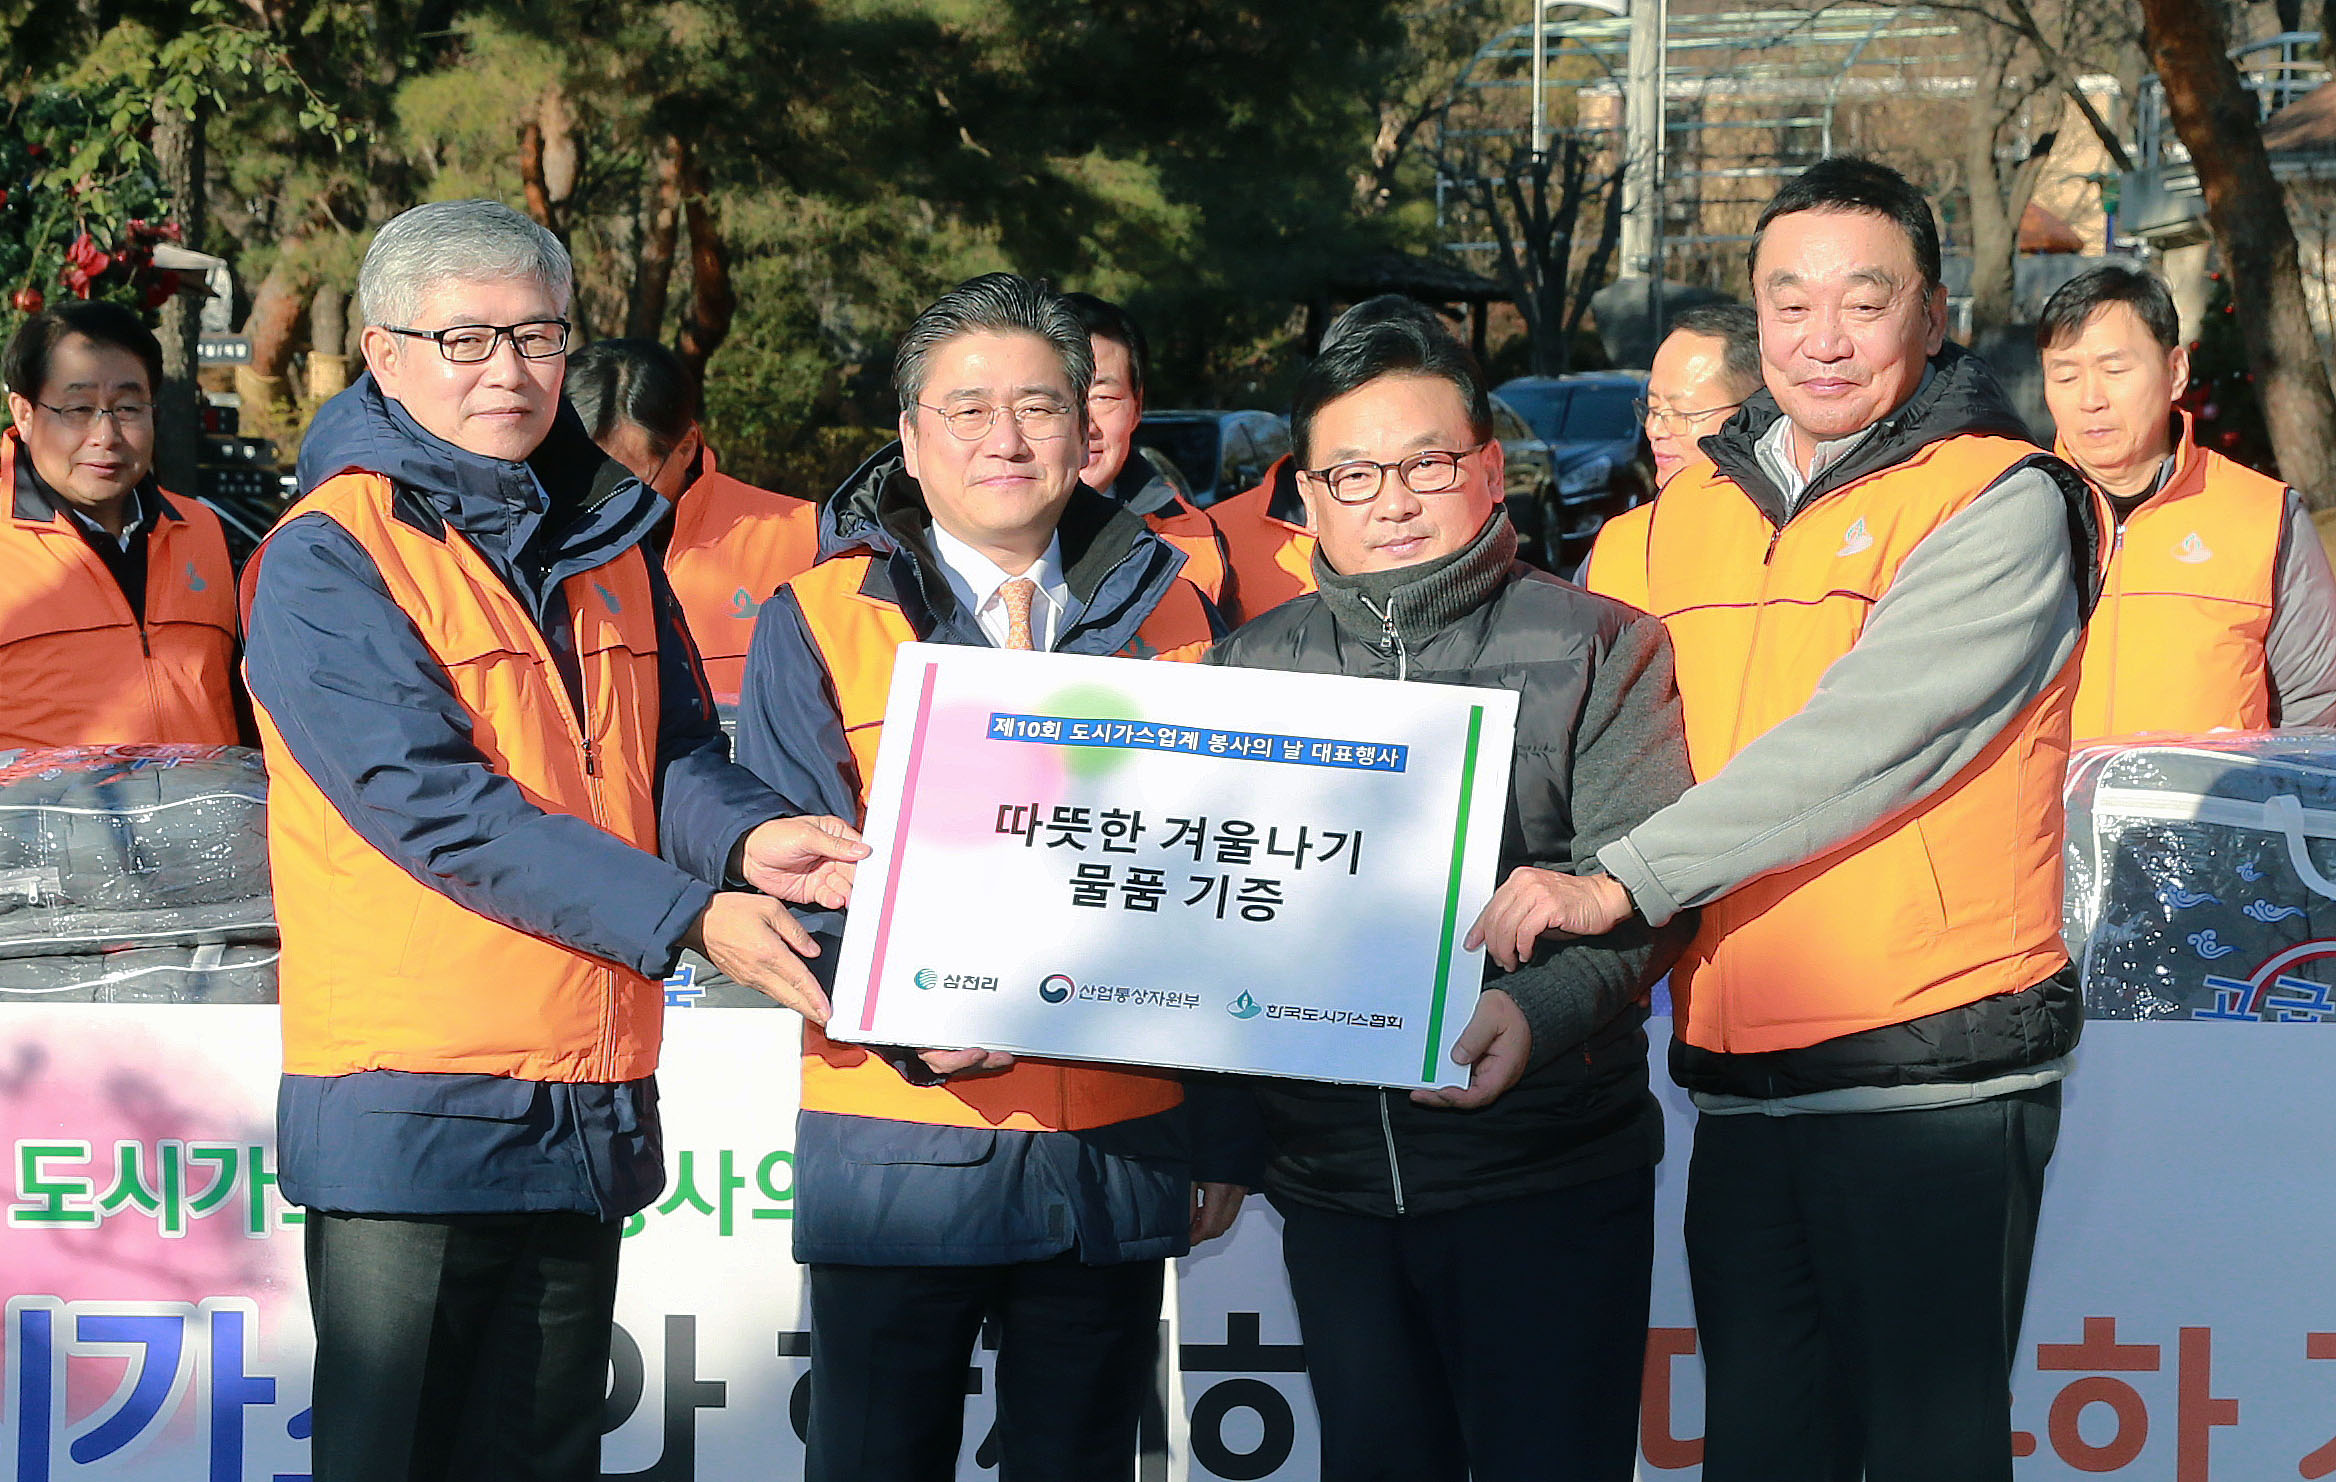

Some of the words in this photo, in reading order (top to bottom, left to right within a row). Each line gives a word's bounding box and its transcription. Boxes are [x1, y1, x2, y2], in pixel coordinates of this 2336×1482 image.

[993, 717, 1062, 741] 제10회
[1069, 723, 1199, 751] 도시가스업계
[1208, 733, 1273, 758] 봉사의
[1283, 739, 1304, 760] 날
[1311, 742, 1399, 768] 대표행사
[995, 802, 1147, 854] 따뜻한
[1159, 816, 1363, 876] 겨울나기
[1068, 863, 1168, 913] 물품
[1183, 874, 1284, 922] 기증
[943, 973, 999, 992] 삼천리
[1078, 983, 1200, 1009] 산업통상자원부
[1266, 1004, 1403, 1030] 한국도시가스협회
